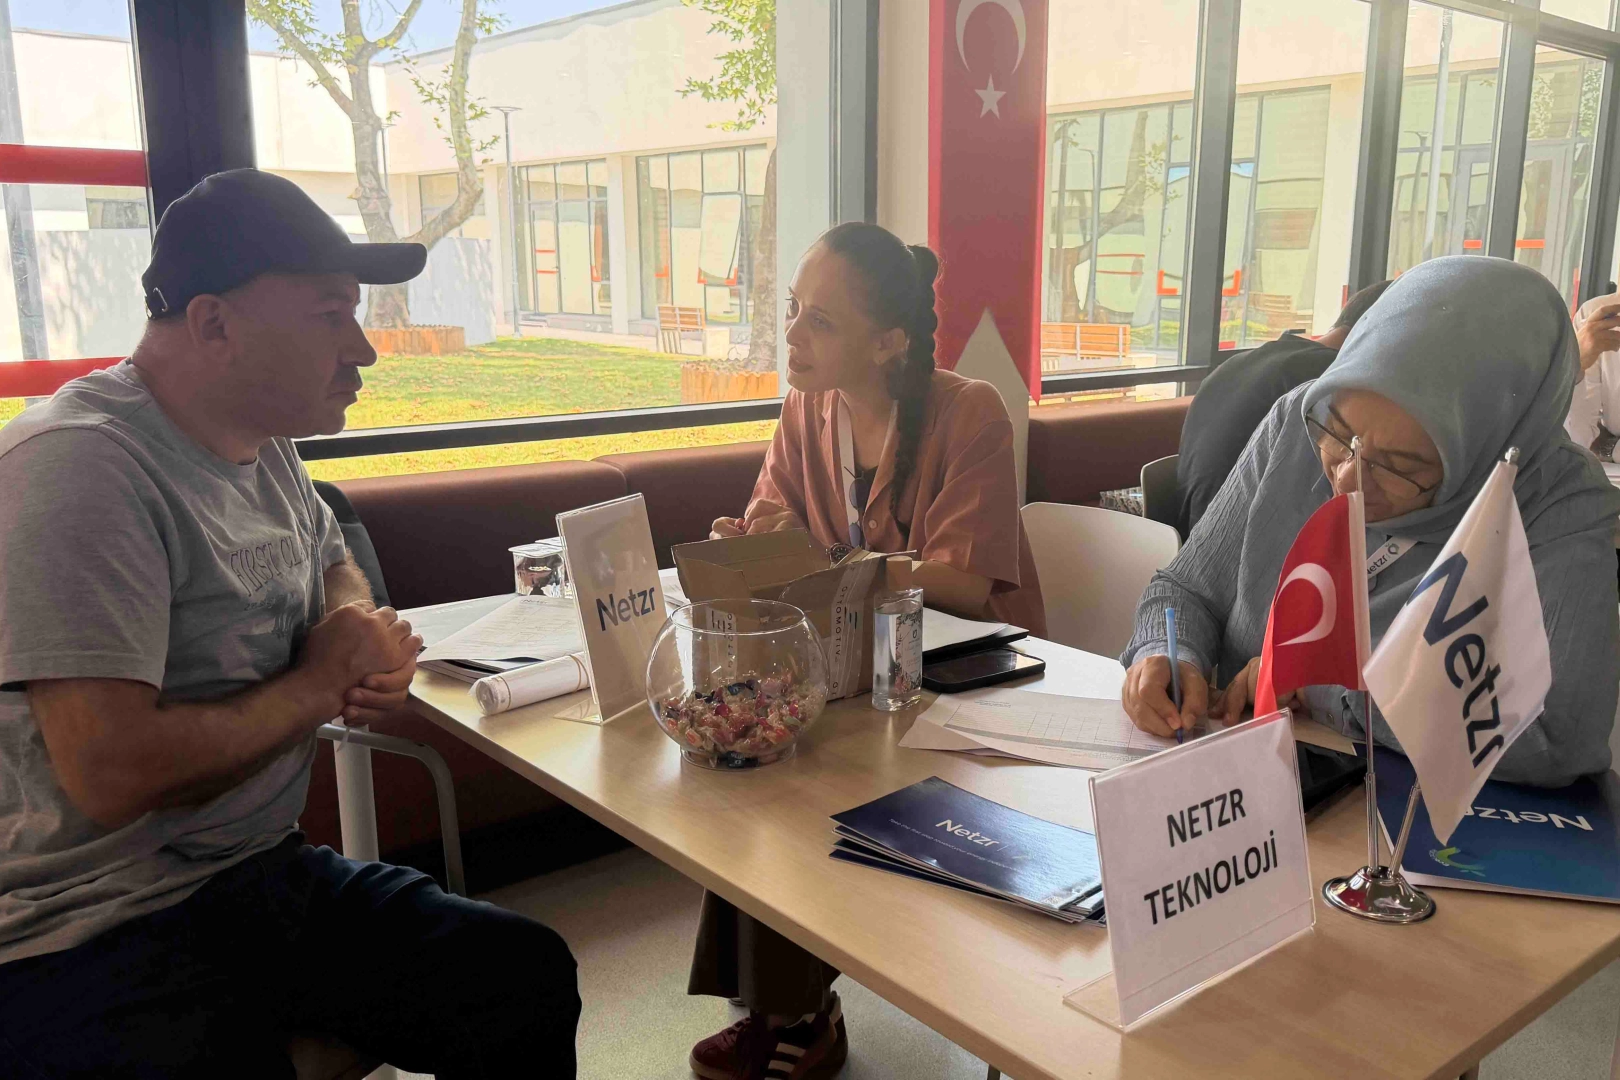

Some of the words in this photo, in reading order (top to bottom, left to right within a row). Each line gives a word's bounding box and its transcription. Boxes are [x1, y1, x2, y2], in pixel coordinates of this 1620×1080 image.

[230, 542, 282, 597] FIRST
[595, 586, 656, 632] Netzr
[1405, 551, 1505, 769] Netzr
[935, 819, 1000, 847] Netzr
[1166, 788, 1247, 848] NETZR
[1143, 829, 1279, 926] TEKNOLOJİ
